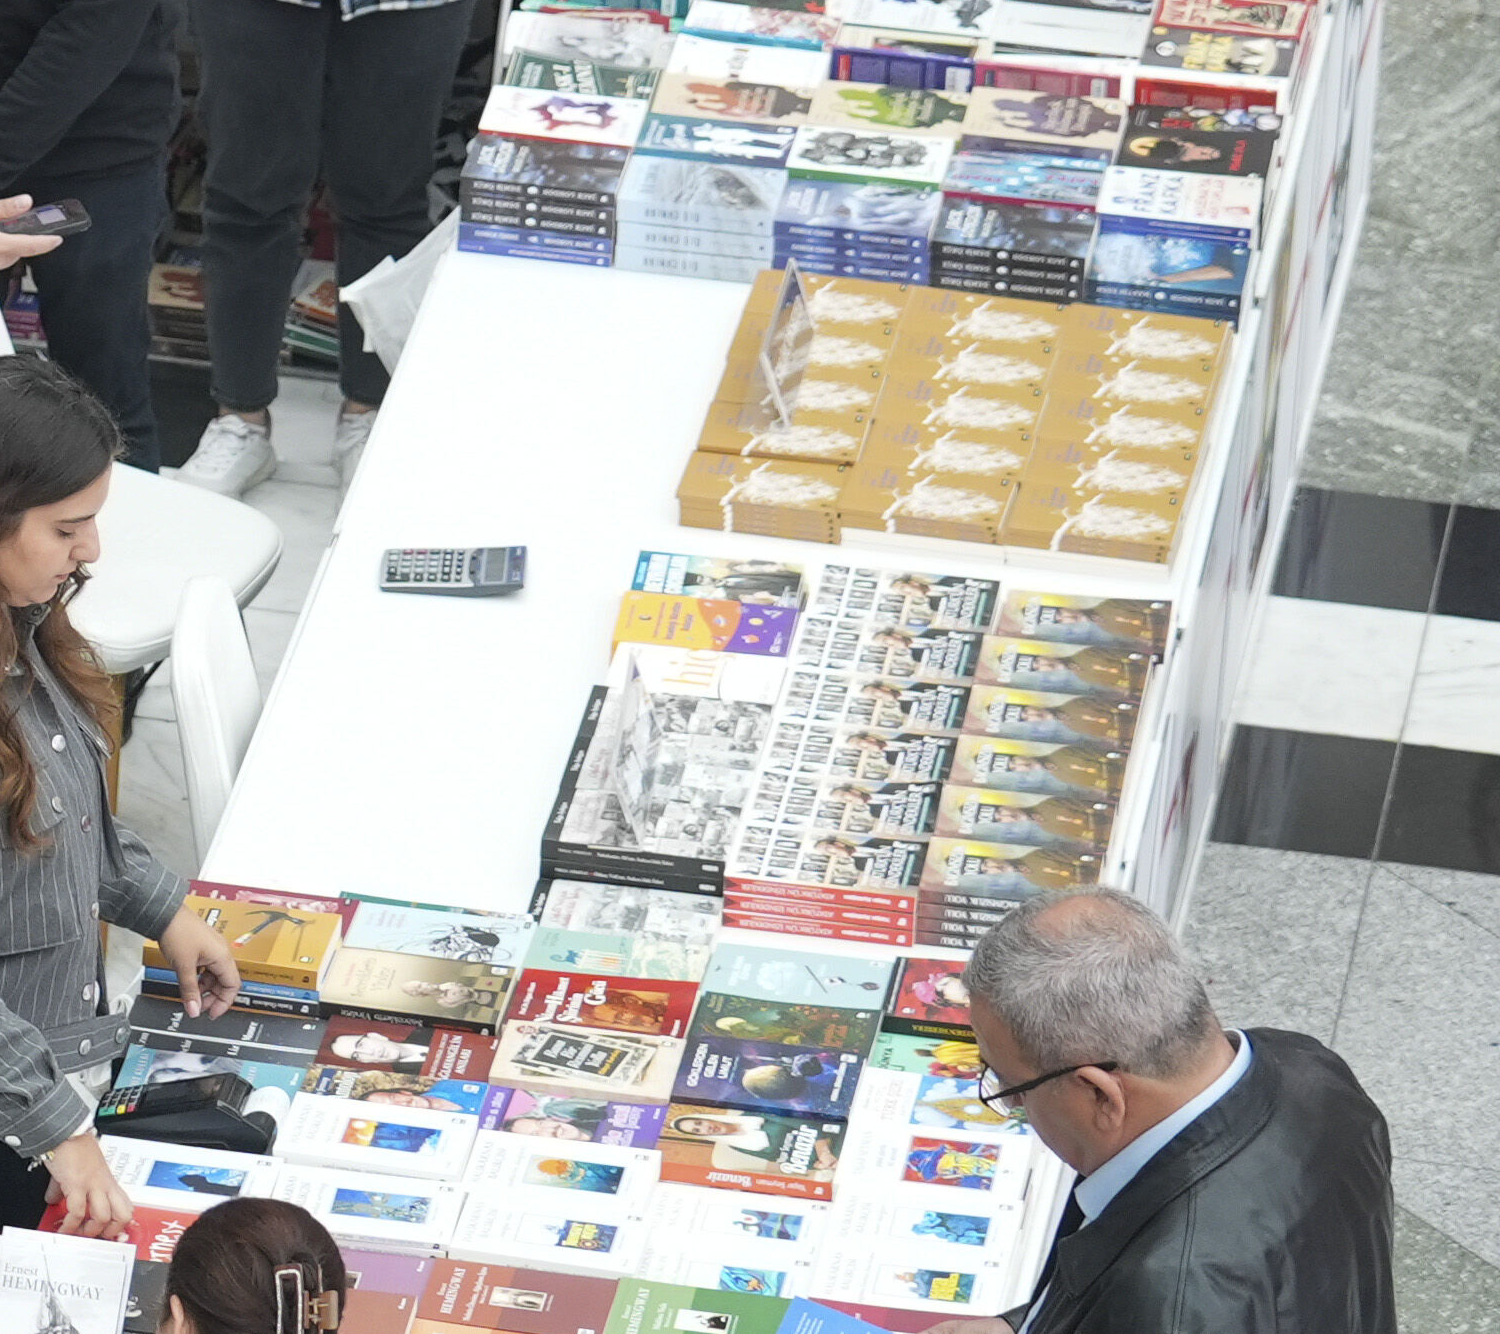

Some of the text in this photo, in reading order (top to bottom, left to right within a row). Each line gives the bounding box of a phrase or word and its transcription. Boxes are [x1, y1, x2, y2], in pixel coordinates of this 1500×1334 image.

[779, 1123, 818, 1174] Benazir
[2, 1273, 105, 1302] HEMINGWAY
[3, 1261, 39, 1276] Ernest
[440, 1266, 466, 1314] HEMINGWAY
